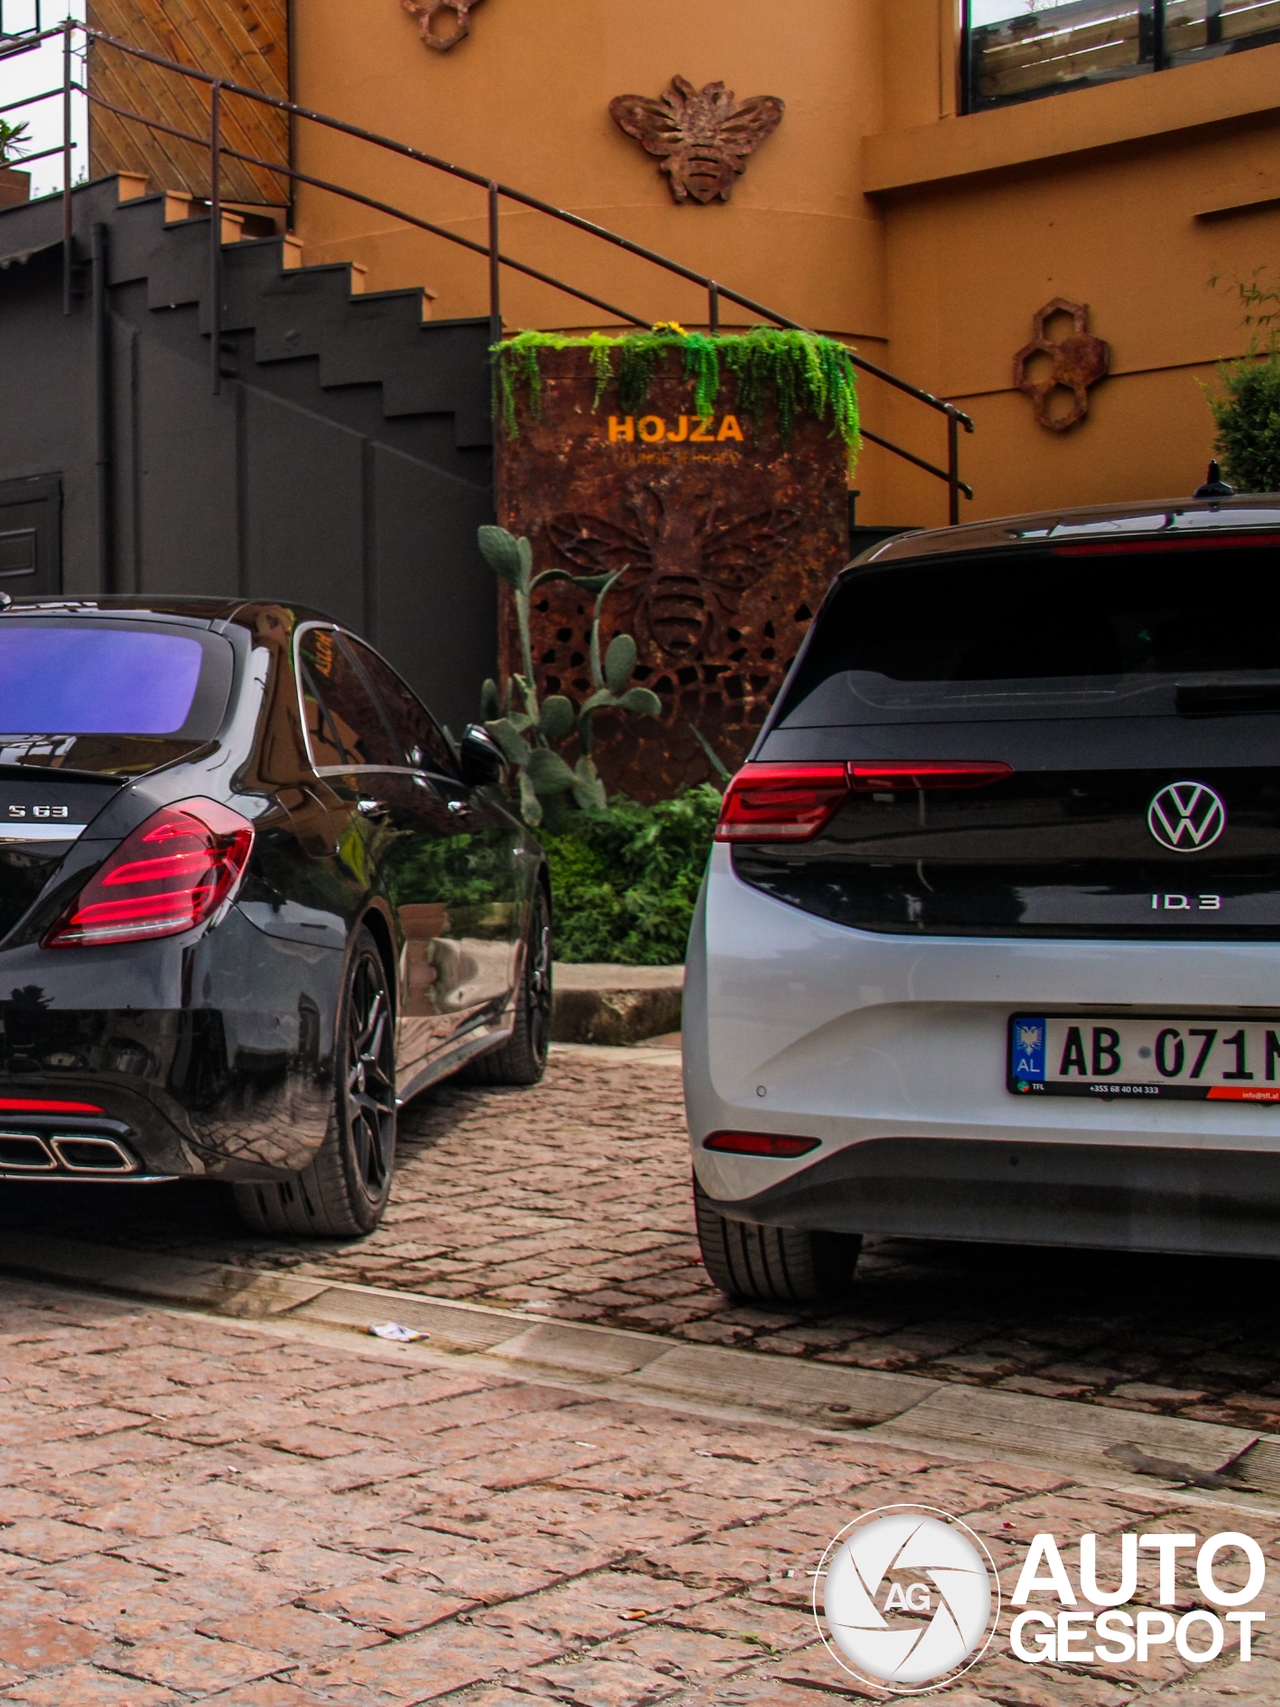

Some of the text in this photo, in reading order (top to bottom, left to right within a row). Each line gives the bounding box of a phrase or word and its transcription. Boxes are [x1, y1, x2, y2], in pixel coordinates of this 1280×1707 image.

[608, 414, 745, 442] HOJZA
[8, 805, 69, 818] S 63
[1017, 1058, 1040, 1072] AL
[1032, 1083, 1045, 1091] TFL
[1090, 1085, 1109, 1093] +355
[1121, 1086, 1131, 1094] 40
[1132, 1086, 1143, 1094] 04
[1144, 1086, 1159, 1094] 333
